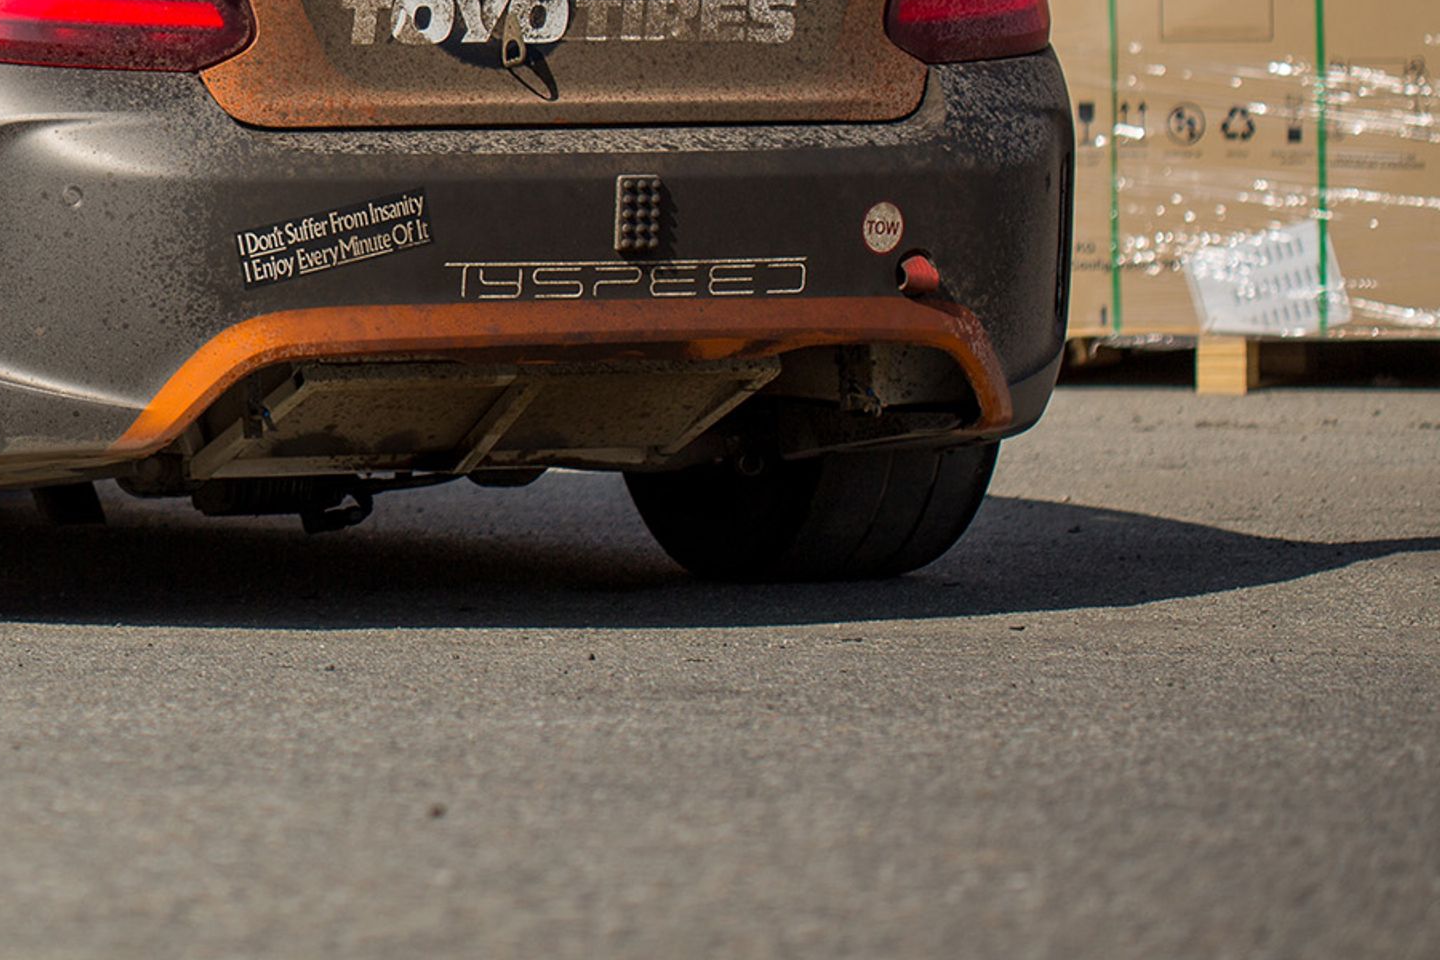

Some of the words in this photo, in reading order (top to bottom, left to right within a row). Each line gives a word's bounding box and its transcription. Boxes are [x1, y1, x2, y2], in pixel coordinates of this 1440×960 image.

[237, 234, 245, 256] I
[284, 217, 329, 245] Suffer
[329, 211, 369, 237] From
[368, 195, 425, 224] Insanity
[243, 261, 252, 283] I
[252, 255, 295, 282] Enjoy
[295, 244, 339, 270] Every
[337, 232, 392, 259] Minute
[391, 221, 413, 245] Of
[415, 218, 431, 240] It
[867, 220, 899, 235] TOW
